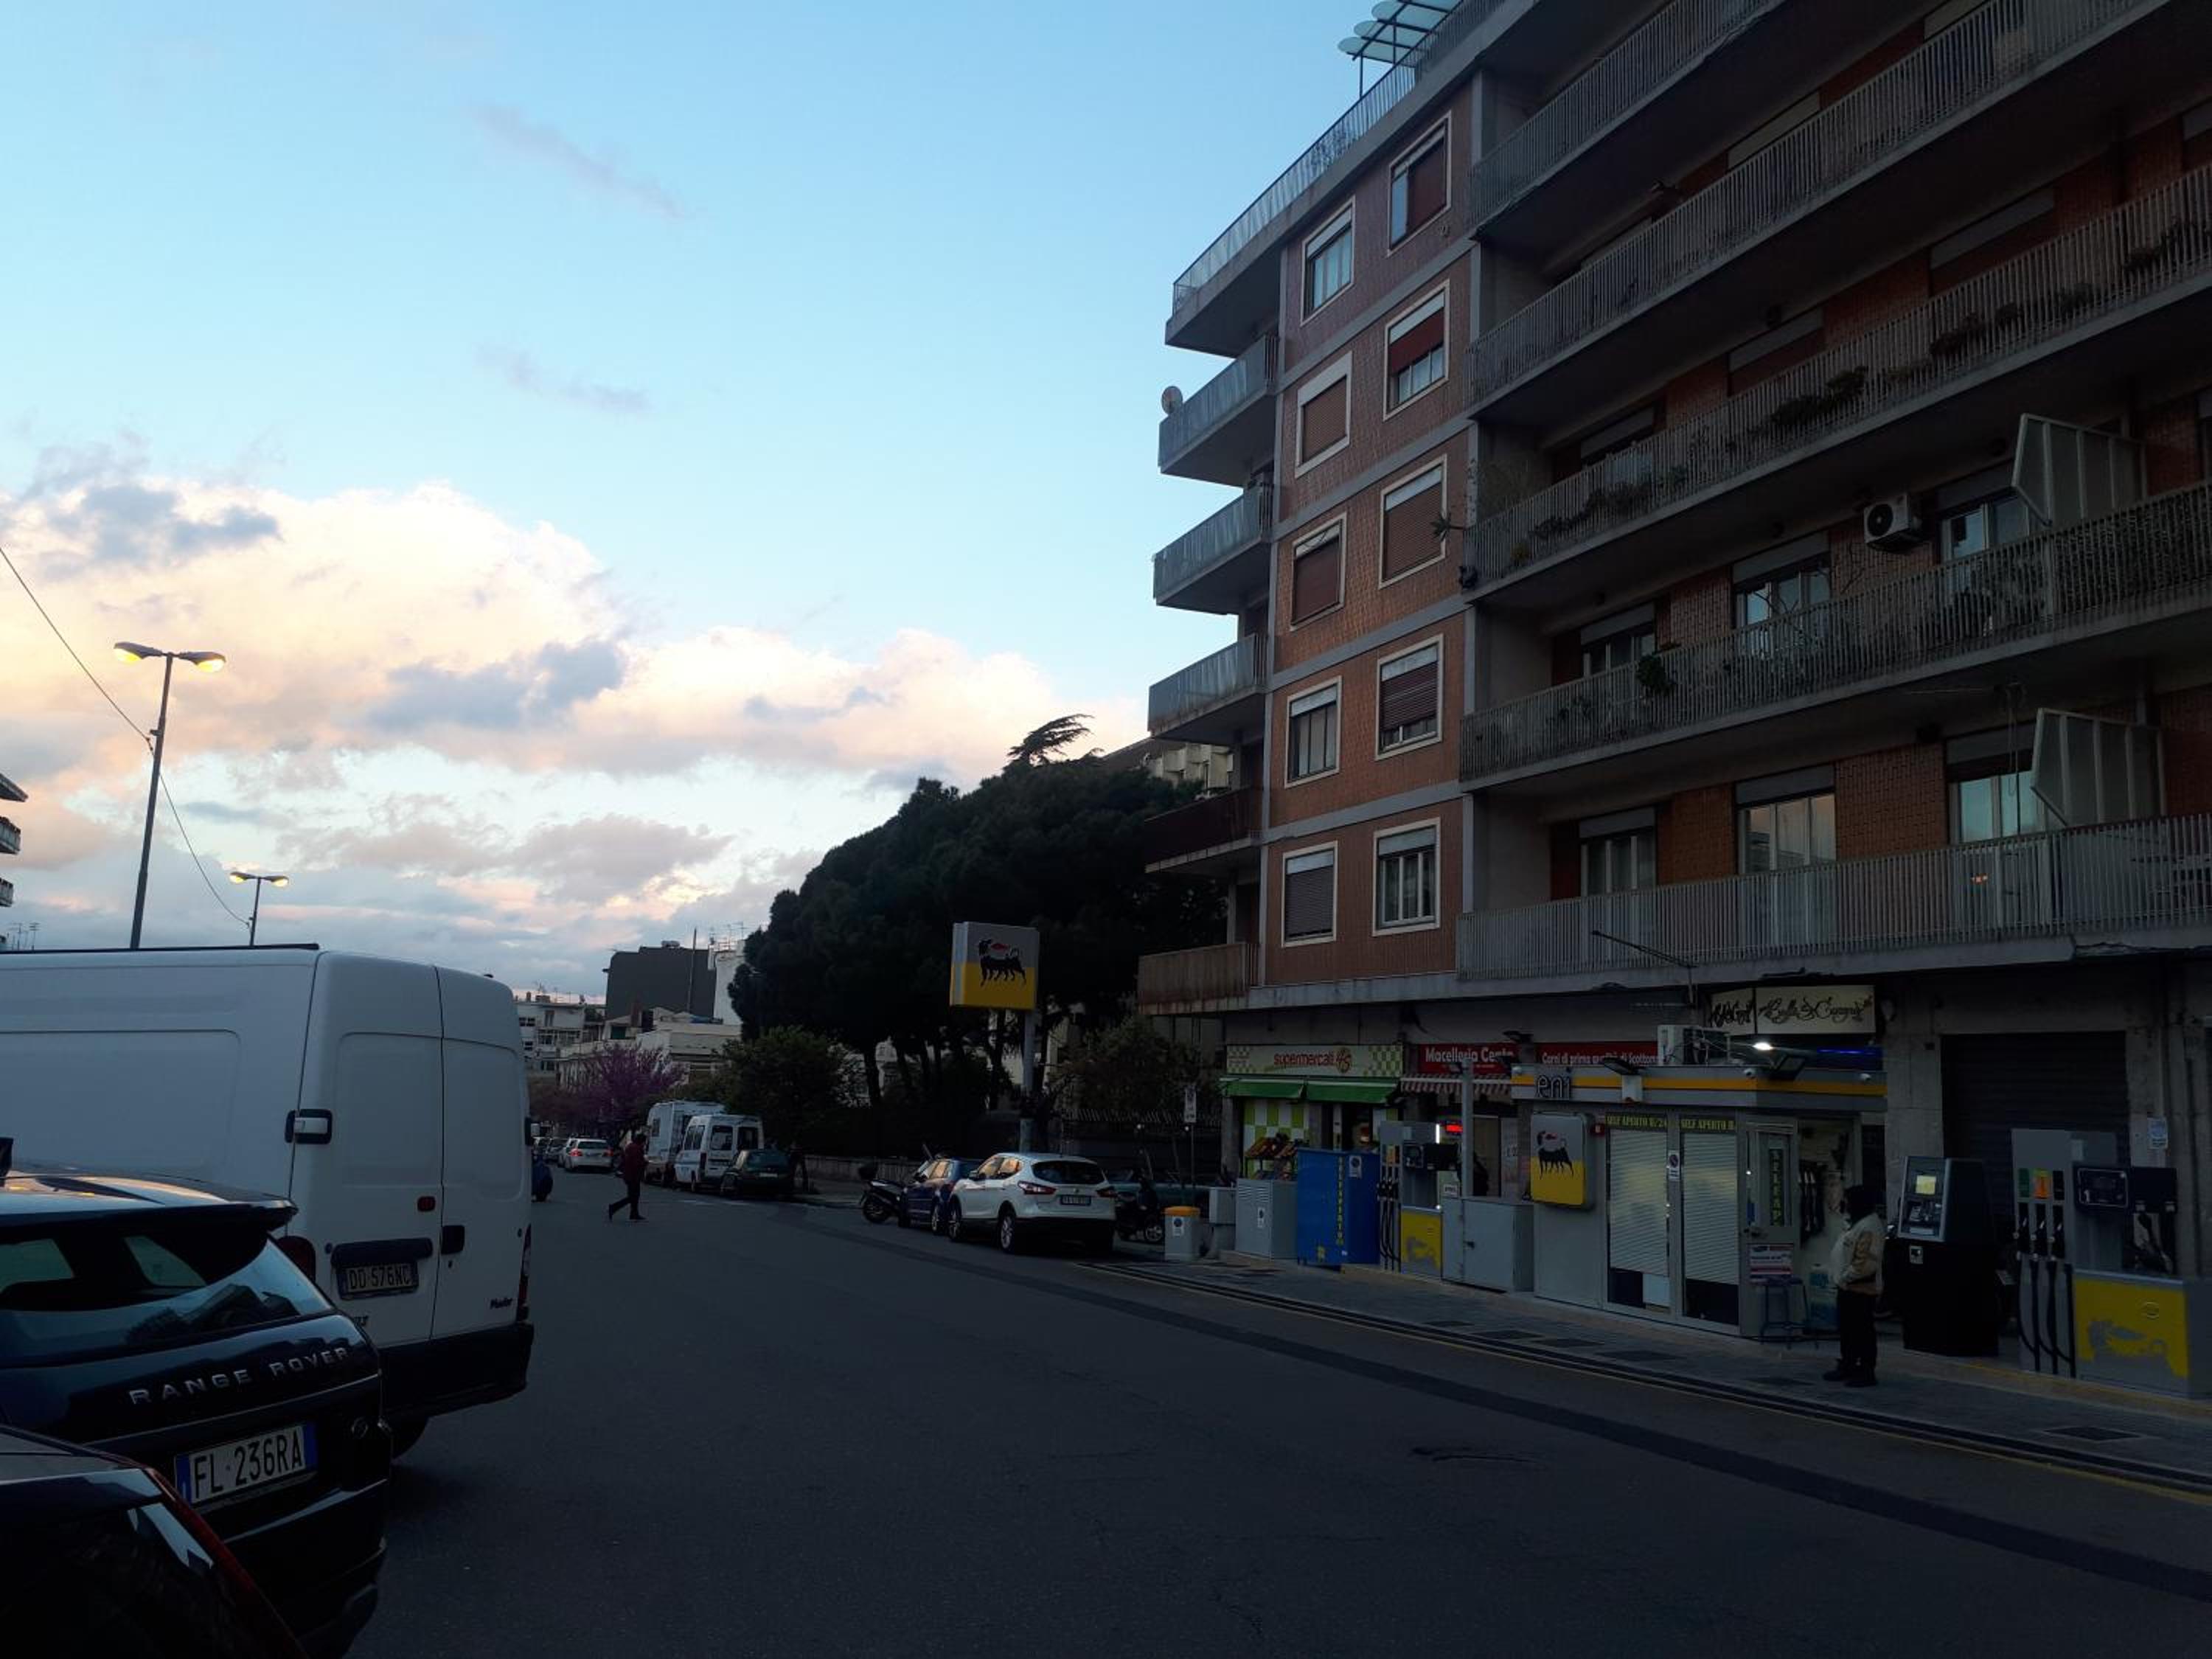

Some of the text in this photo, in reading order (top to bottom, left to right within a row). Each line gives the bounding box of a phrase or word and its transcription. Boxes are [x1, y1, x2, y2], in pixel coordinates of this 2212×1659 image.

[1536, 1068, 1571, 1099] eni
[129, 1346, 349, 1405] RANGE ROVER
[192, 1432, 305, 1500] FL 236RA
